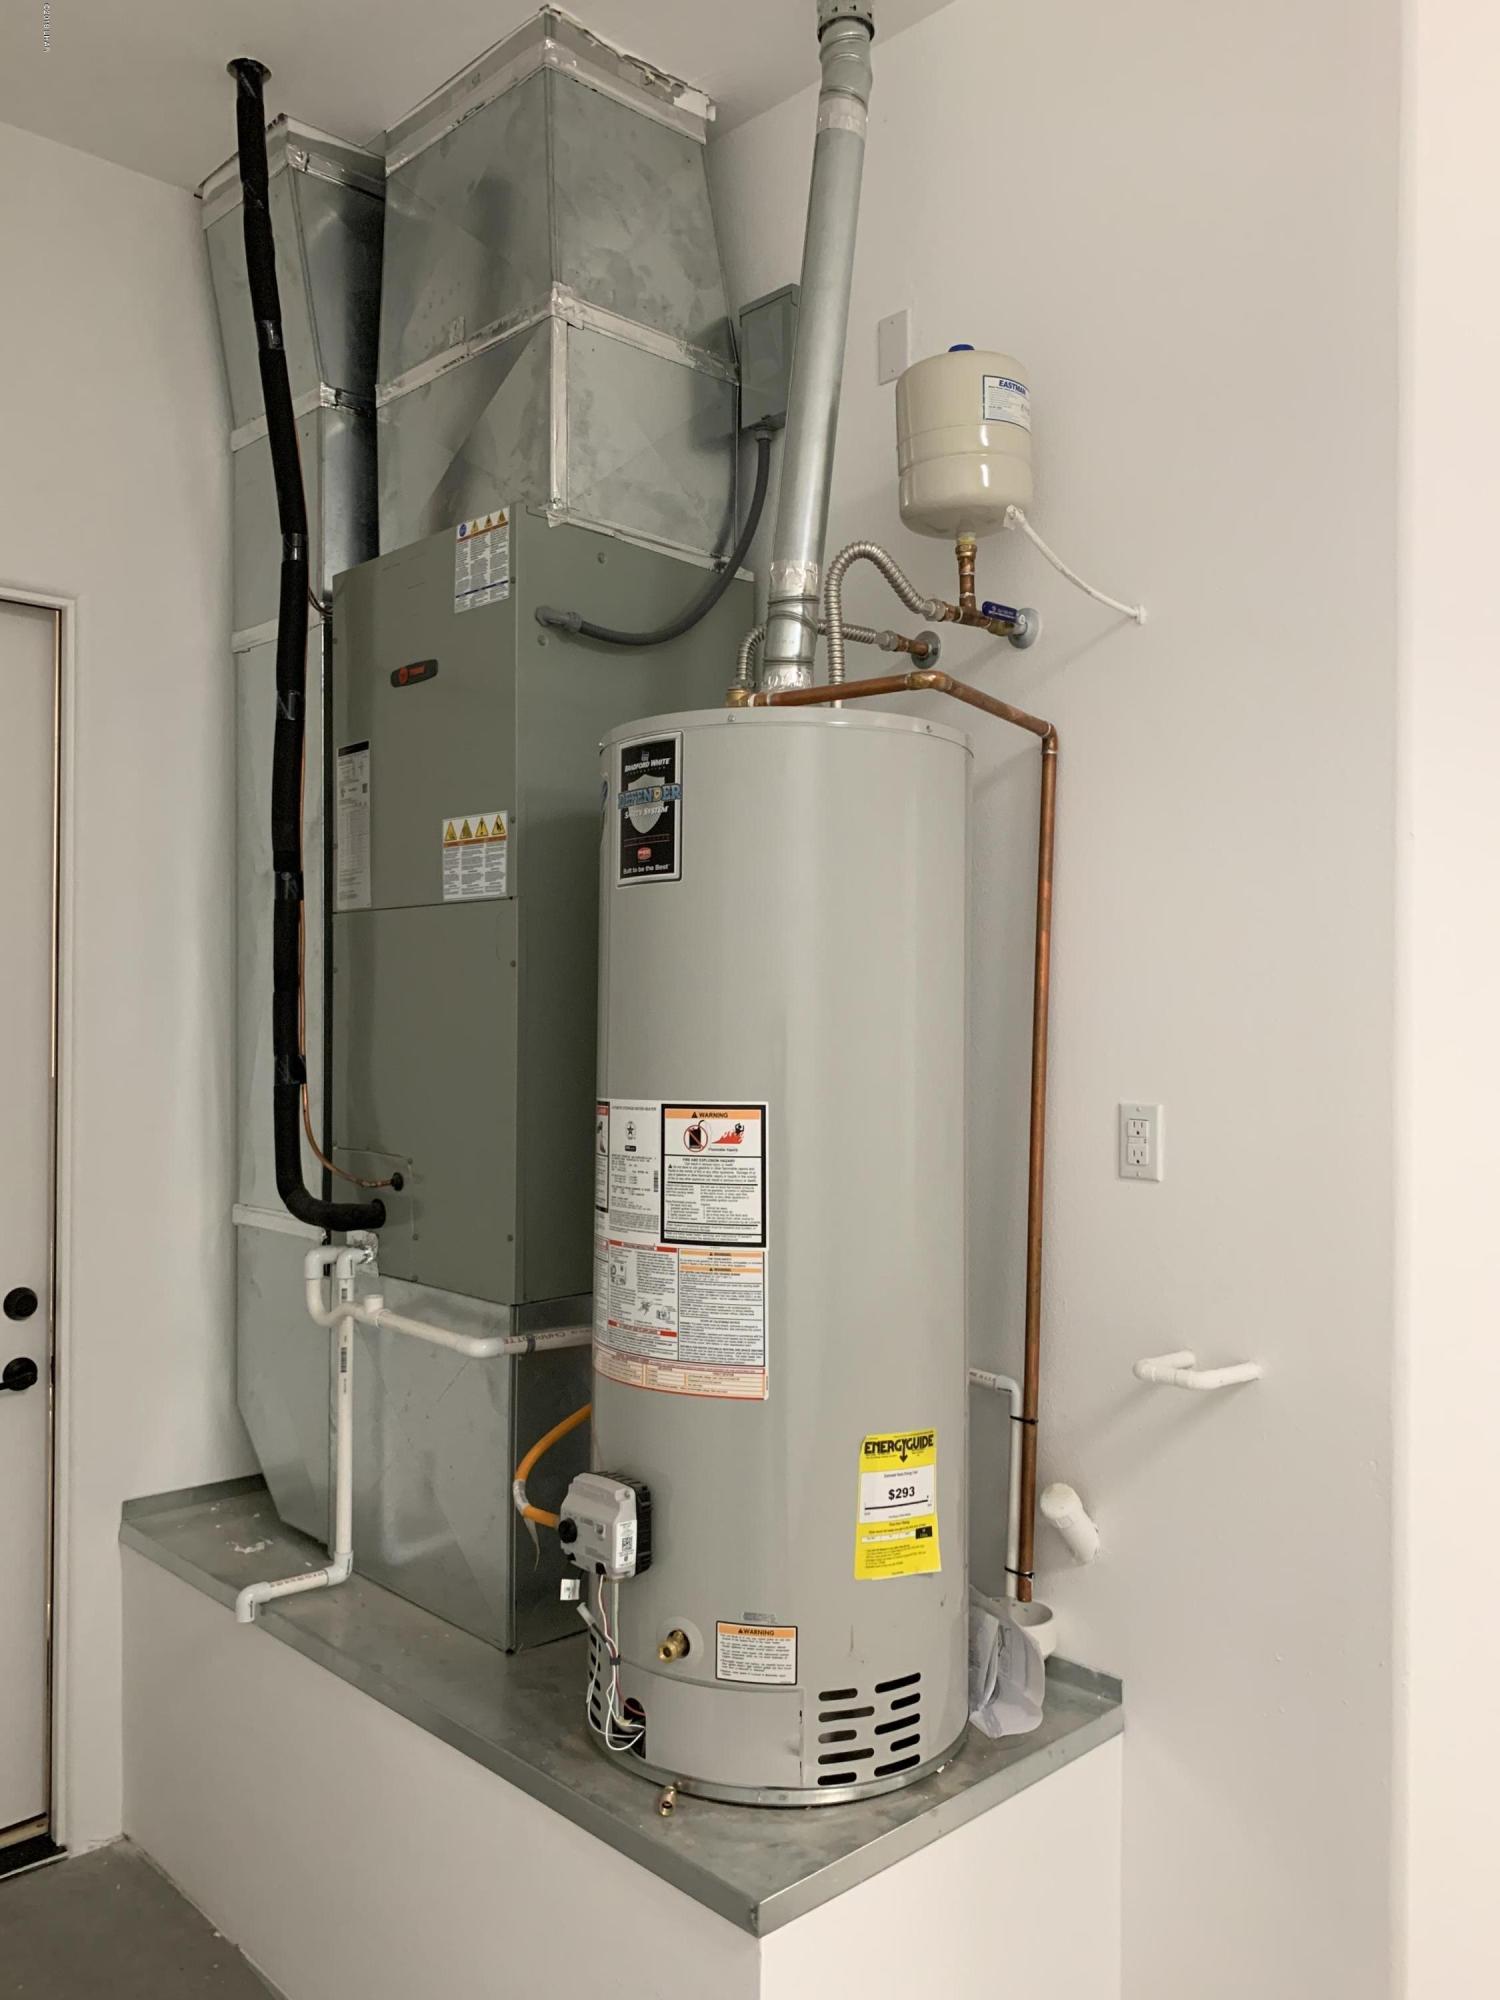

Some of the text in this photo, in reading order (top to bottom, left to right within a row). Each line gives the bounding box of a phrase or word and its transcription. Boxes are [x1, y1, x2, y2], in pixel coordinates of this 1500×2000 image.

[650, 758, 670, 767] WHITE
[864, 1434, 934, 1456] ENERGYGUIDE
[888, 1486, 915, 1501] $293
[743, 1628, 774, 1636] WARNING
